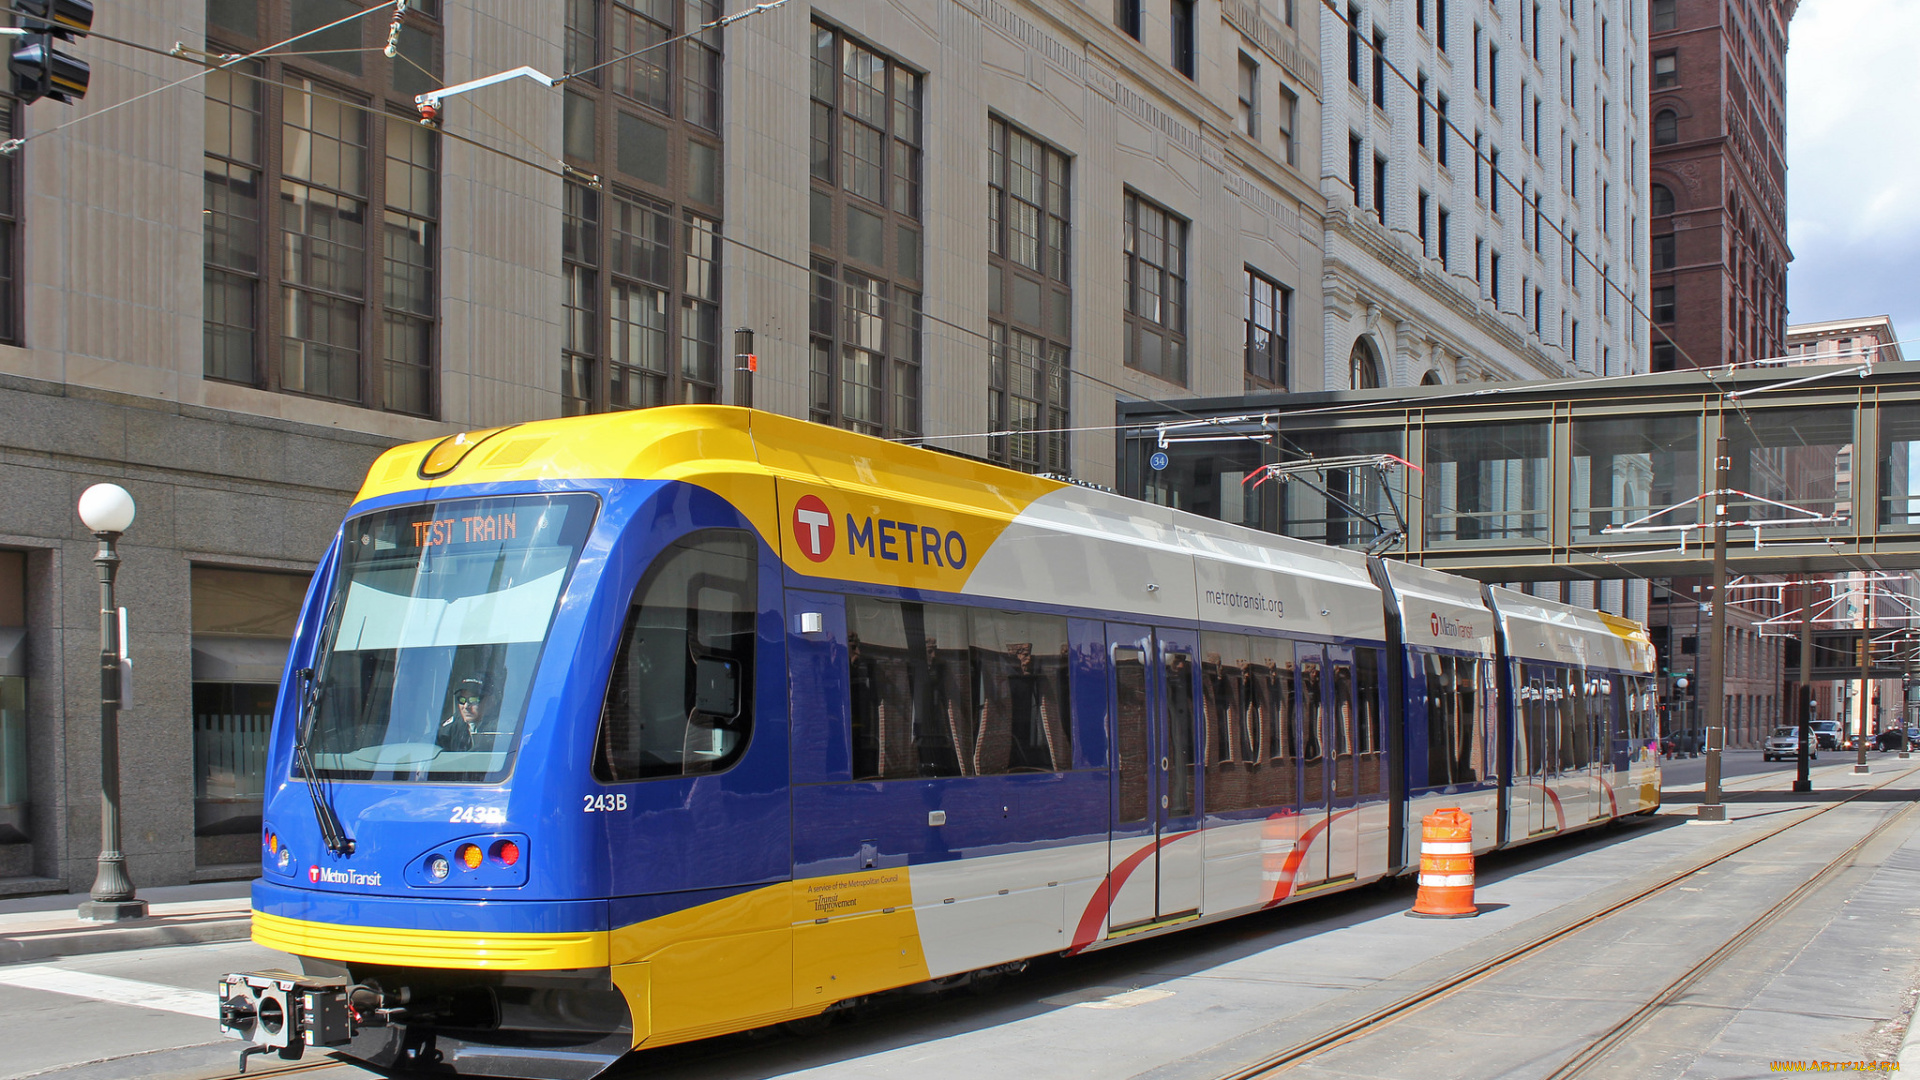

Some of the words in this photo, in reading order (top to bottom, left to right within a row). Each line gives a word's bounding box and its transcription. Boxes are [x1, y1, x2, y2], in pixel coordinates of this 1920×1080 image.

[1153, 456, 1165, 466] 34
[412, 518, 455, 547] TEST
[462, 512, 516, 543] TRAIN
[797, 508, 829, 555] T
[846, 513, 967, 570] METRO
[1206, 589, 1284, 618] metrotransit.org
[584, 793, 627, 812] 243B
[808, 885, 812, 893] A
[813, 883, 831, 892] service
[833, 881, 838, 890] of
[838, 880, 848, 889] the
[848, 878, 880, 888] Metropolitan
[880, 874, 898, 884] Council
[814, 899, 857, 913] Improvement
[818, 893, 838, 904] Transit
